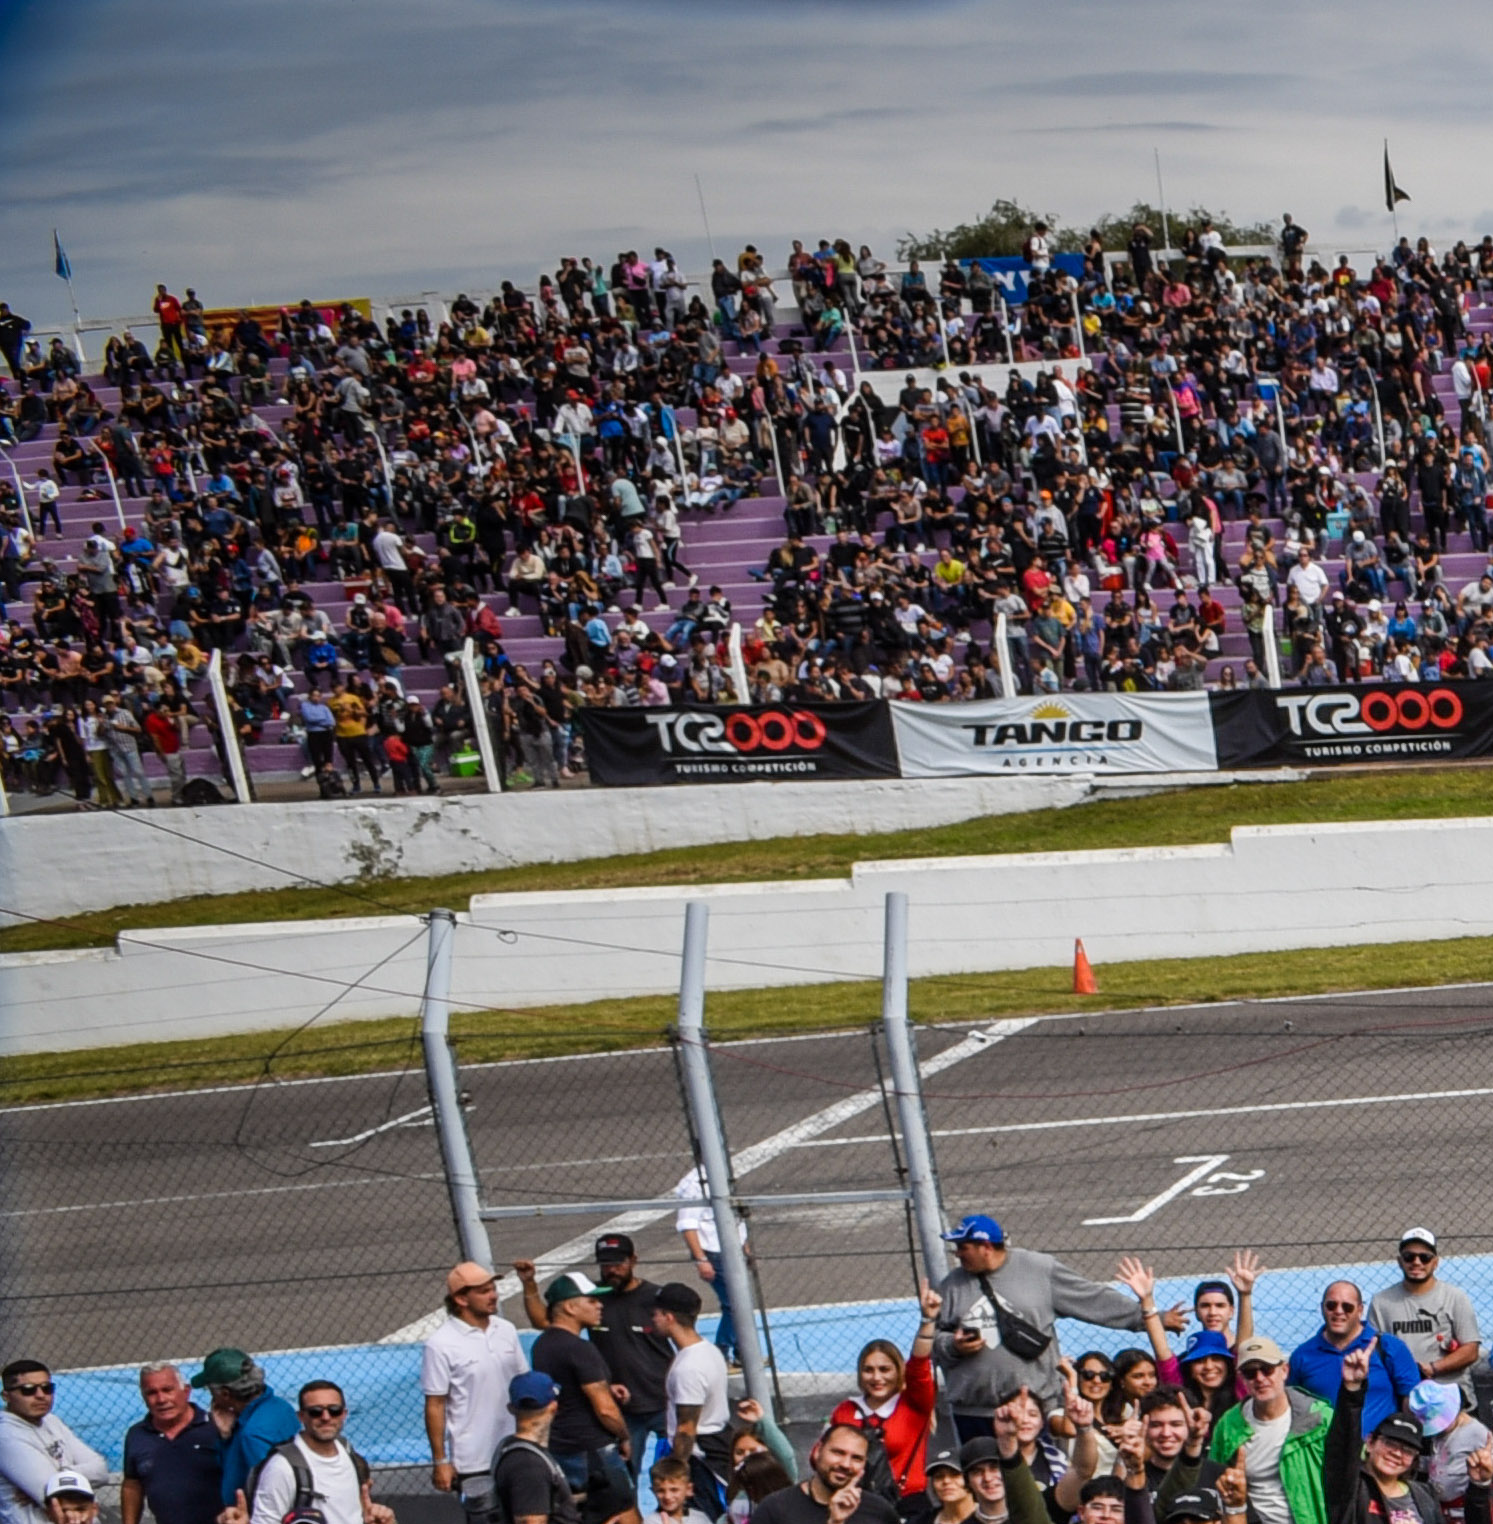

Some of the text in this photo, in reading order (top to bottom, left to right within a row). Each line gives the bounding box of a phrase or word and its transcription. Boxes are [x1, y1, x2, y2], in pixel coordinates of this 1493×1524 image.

[1276, 688, 1464, 736] TC2000
[645, 710, 828, 753] TC2000
[962, 719, 1143, 746] TANGO
[1304, 738, 1452, 758] TURISMO COMPETICIÓN
[675, 759, 817, 775] TURISMO COMPETICIÓN
[1003, 755, 1110, 768] AGENCIA
[1392, 1319, 1434, 1335] PUMA
